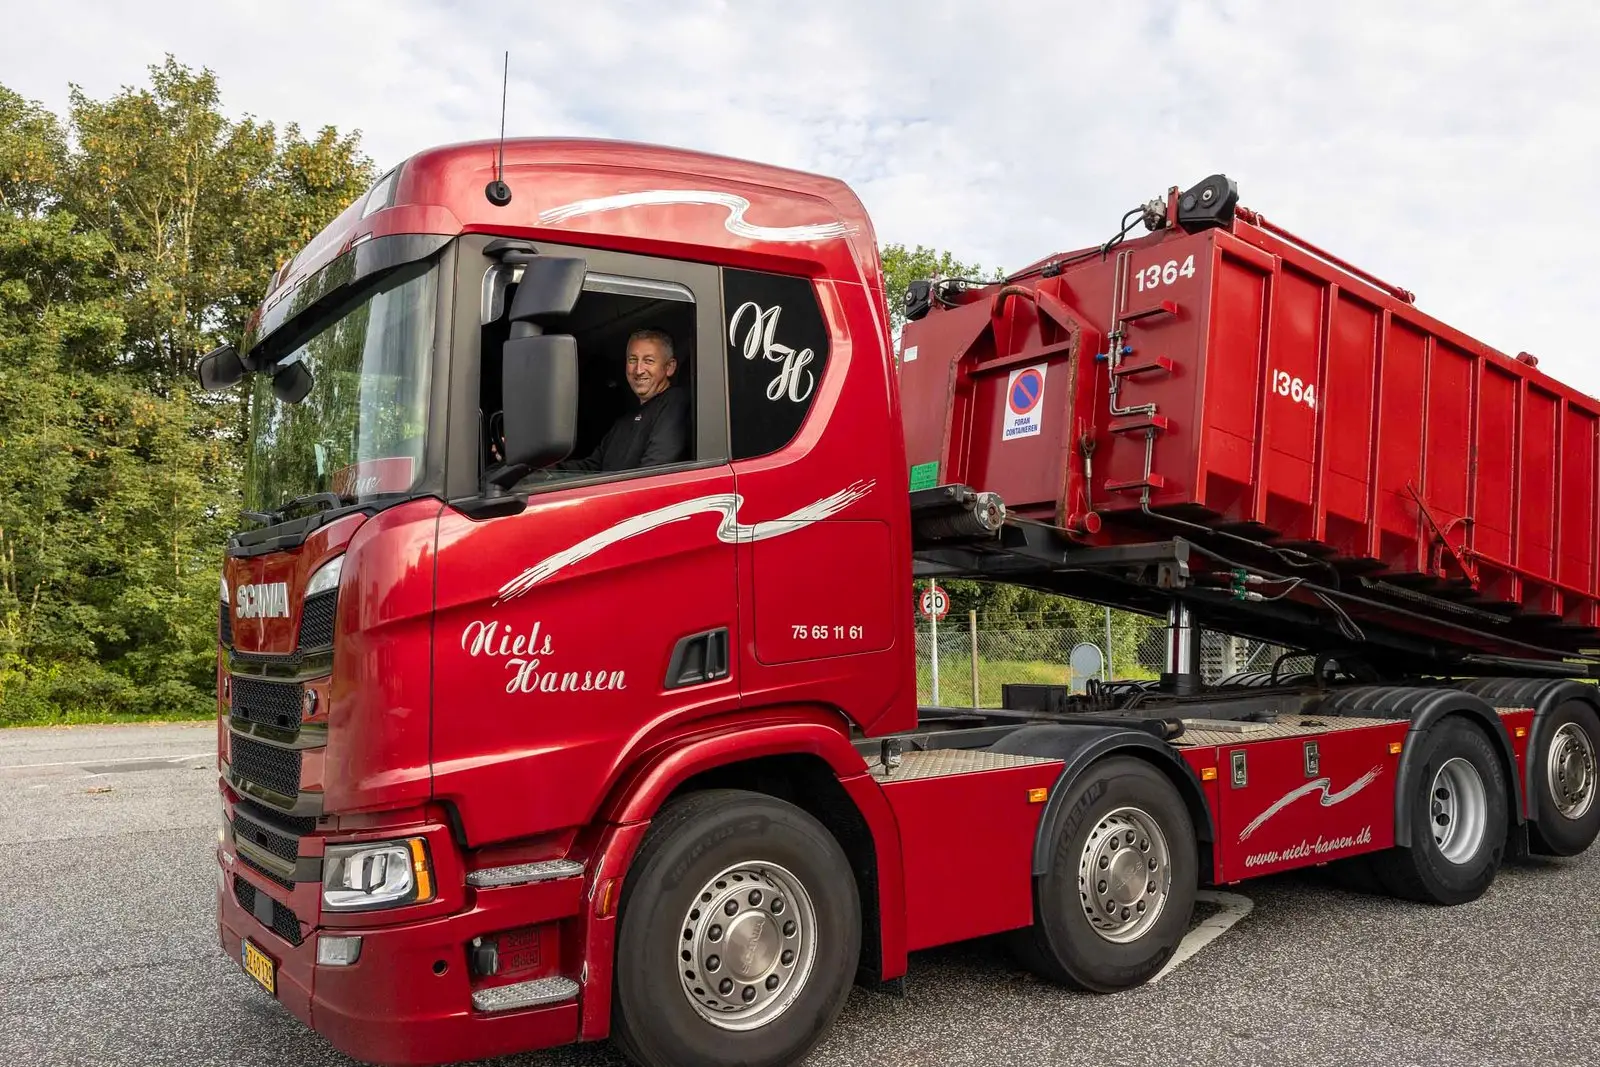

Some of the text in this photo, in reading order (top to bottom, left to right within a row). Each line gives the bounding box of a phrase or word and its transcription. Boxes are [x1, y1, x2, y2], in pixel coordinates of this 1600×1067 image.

[1135, 254, 1196, 292] 1364
[1272, 368, 1315, 409] 1364
[1005, 424, 1038, 436] CONTAINEREN
[1014, 416, 1031, 426] FORAN
[236, 582, 290, 619] SCANIA
[926, 595, 943, 608] 20
[461, 620, 555, 657] Niels
[791, 624, 863, 640] 75 65 11 61
[504, 658, 627, 694] Hansen
[1245, 824, 1372, 868] www.niels-hansen.dk
